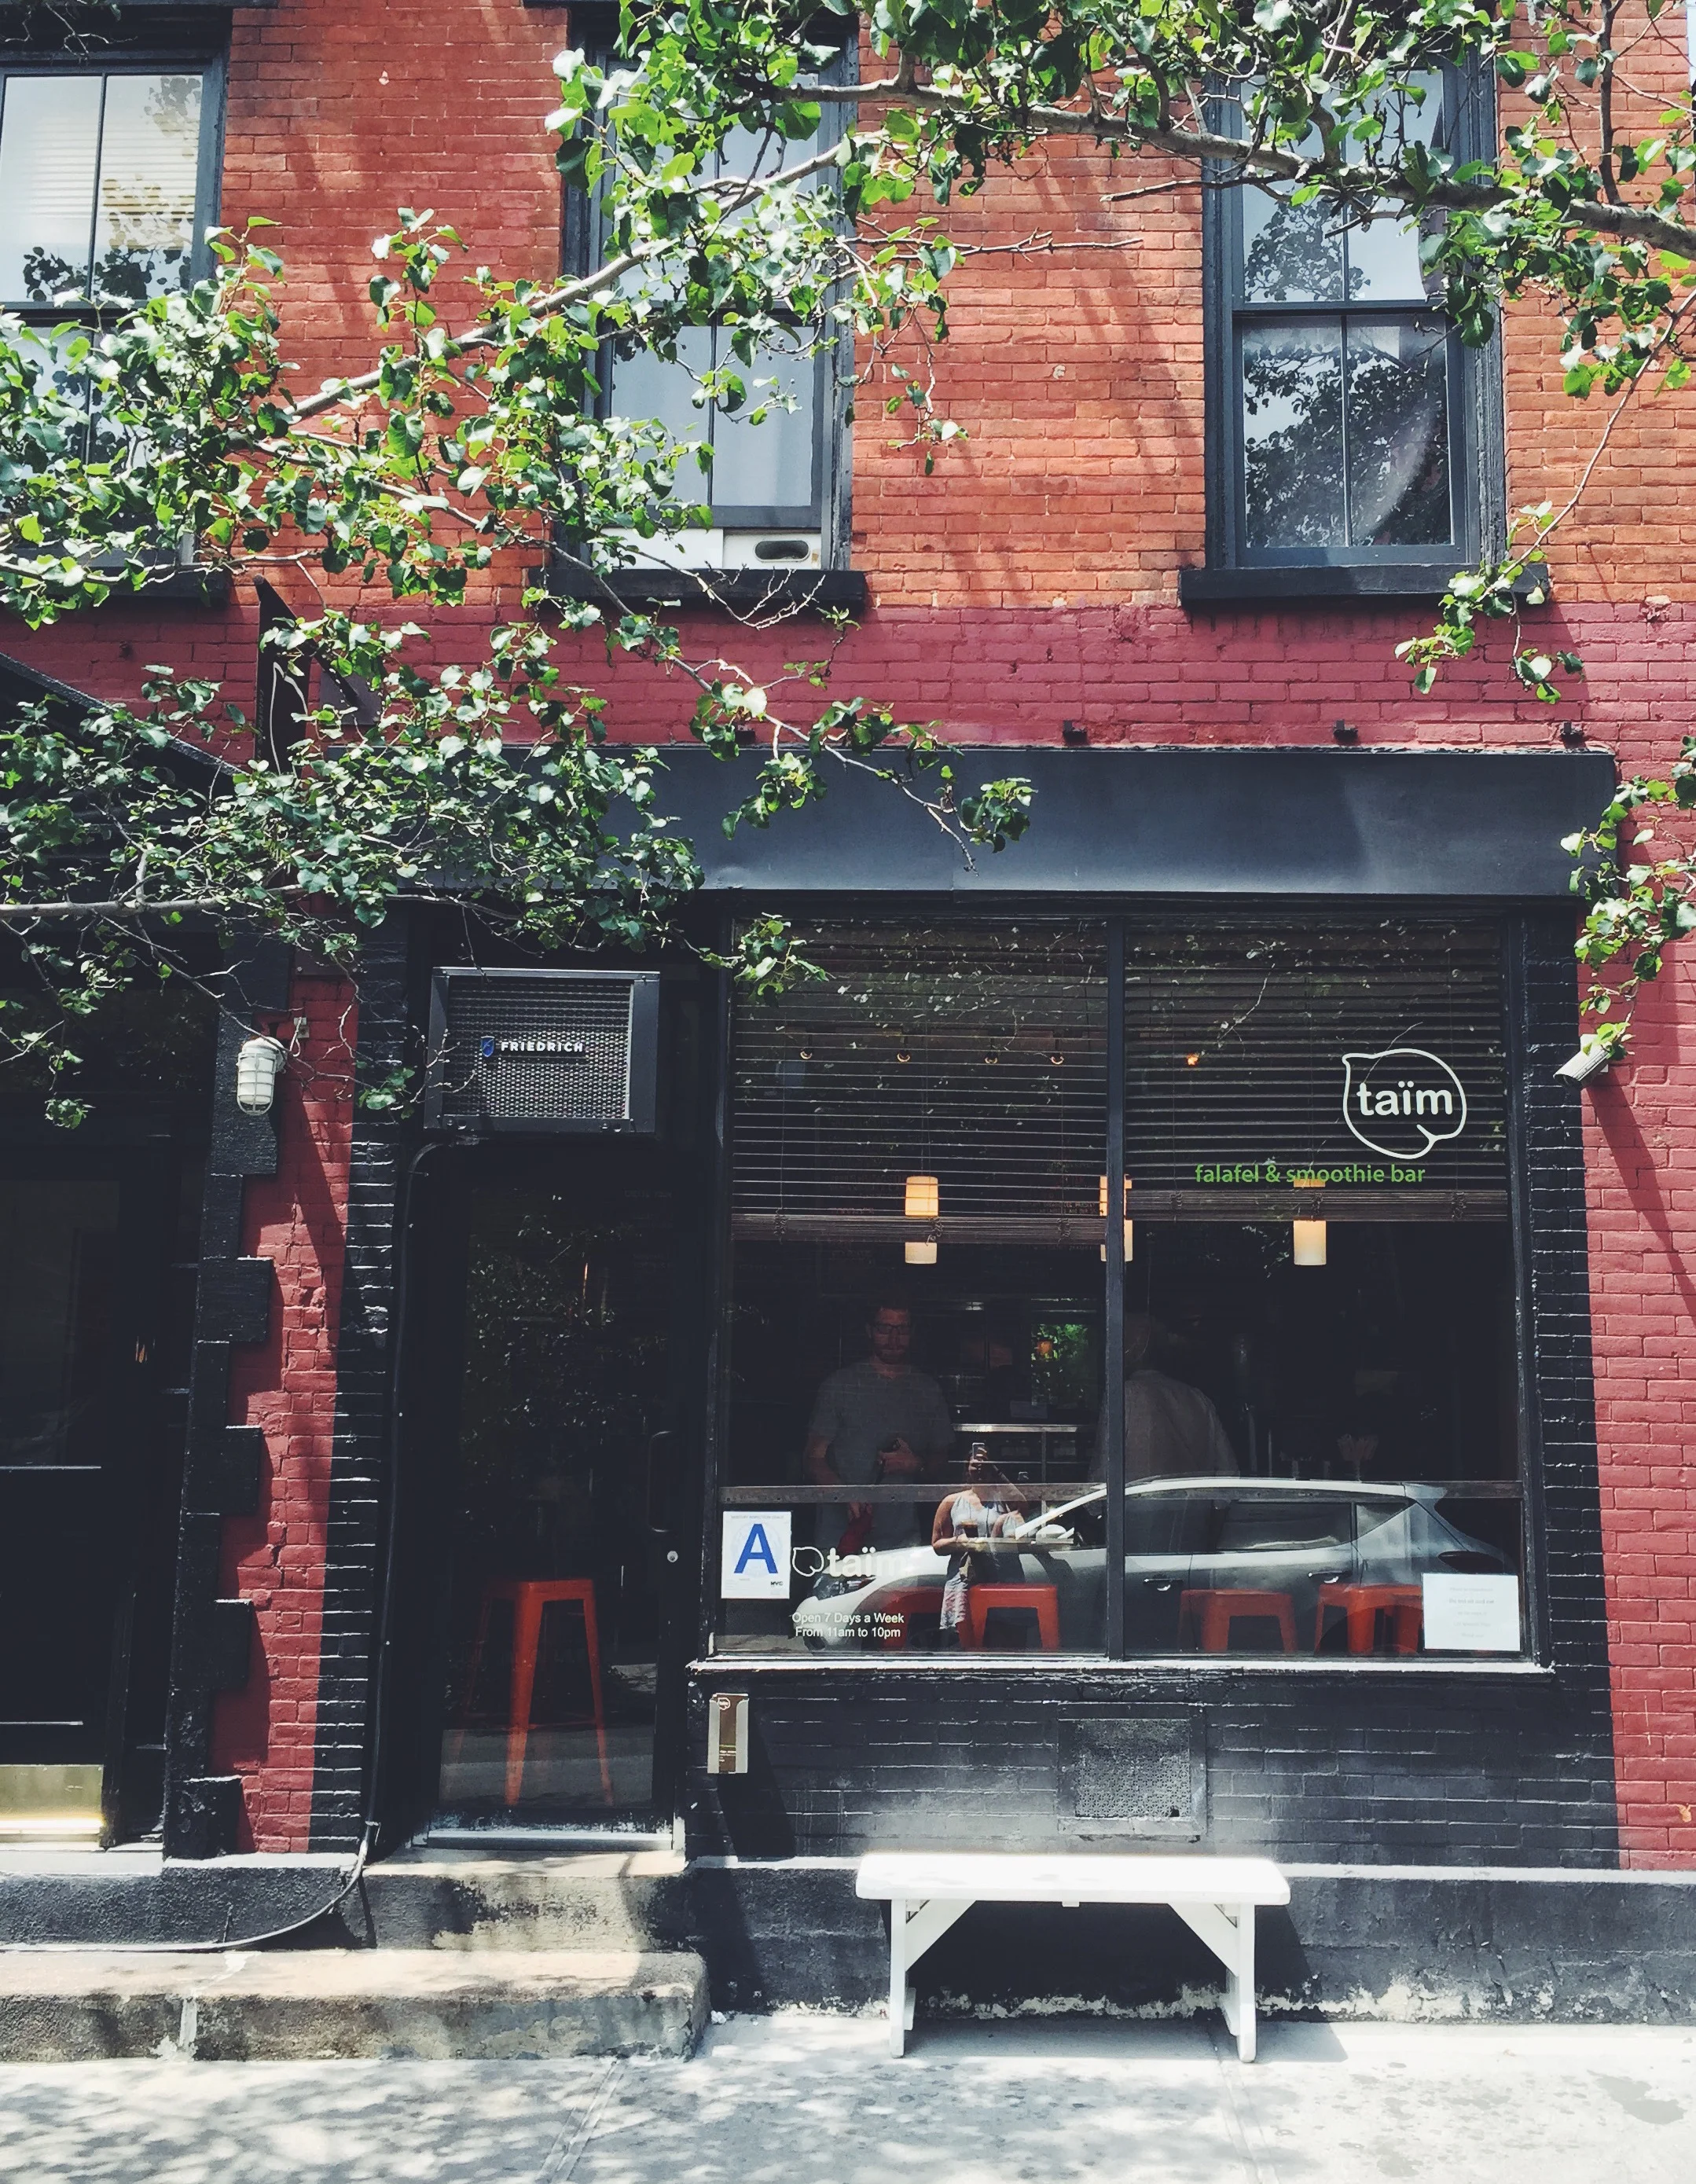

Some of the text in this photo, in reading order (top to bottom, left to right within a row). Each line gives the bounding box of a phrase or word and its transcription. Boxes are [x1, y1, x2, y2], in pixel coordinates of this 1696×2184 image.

[501, 1041, 584, 1052] FRIEDRICH
[1356, 1080, 1453, 1116] taïm
[1195, 1164, 1426, 1183] falafel & smoothie bar
[734, 1523, 779, 1574] A
[791, 1612, 904, 1625] Open 7 Days a Week
[795, 1627, 901, 1639] From 11am to 10pm
